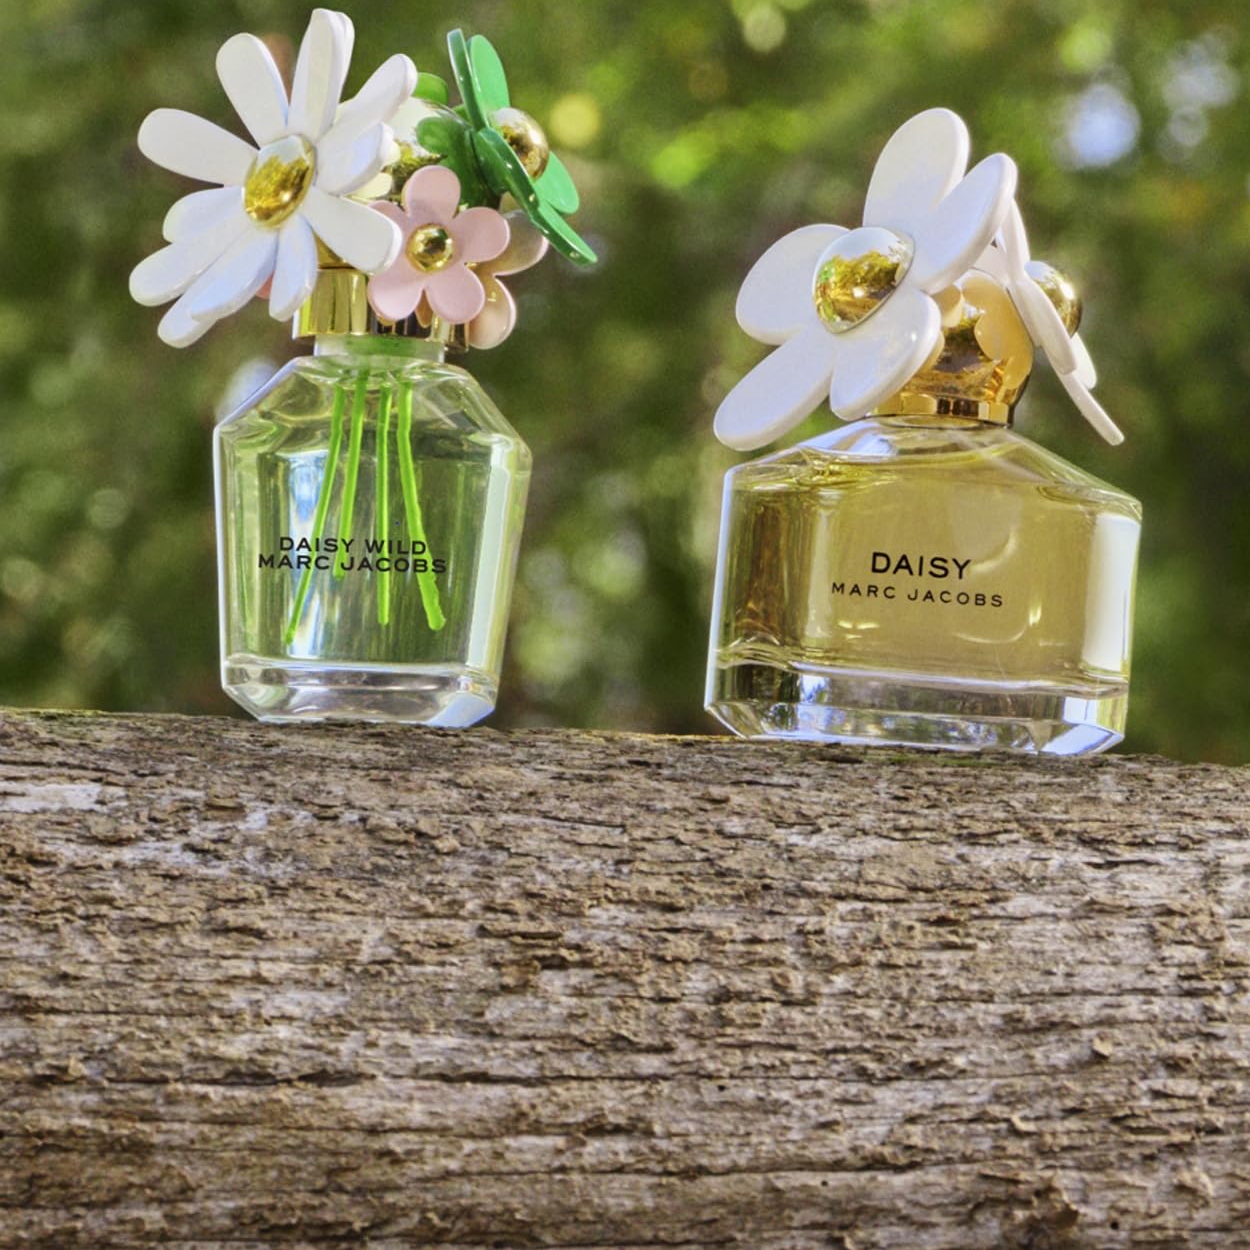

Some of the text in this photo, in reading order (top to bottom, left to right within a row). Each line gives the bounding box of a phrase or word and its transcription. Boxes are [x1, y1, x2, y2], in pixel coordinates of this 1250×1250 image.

[279, 537, 426, 554] DAISY WILD
[258, 554, 448, 573] MARC JACOBS
[871, 552, 971, 579] DAISY
[832, 582, 1003, 607] MARC JACOBS
